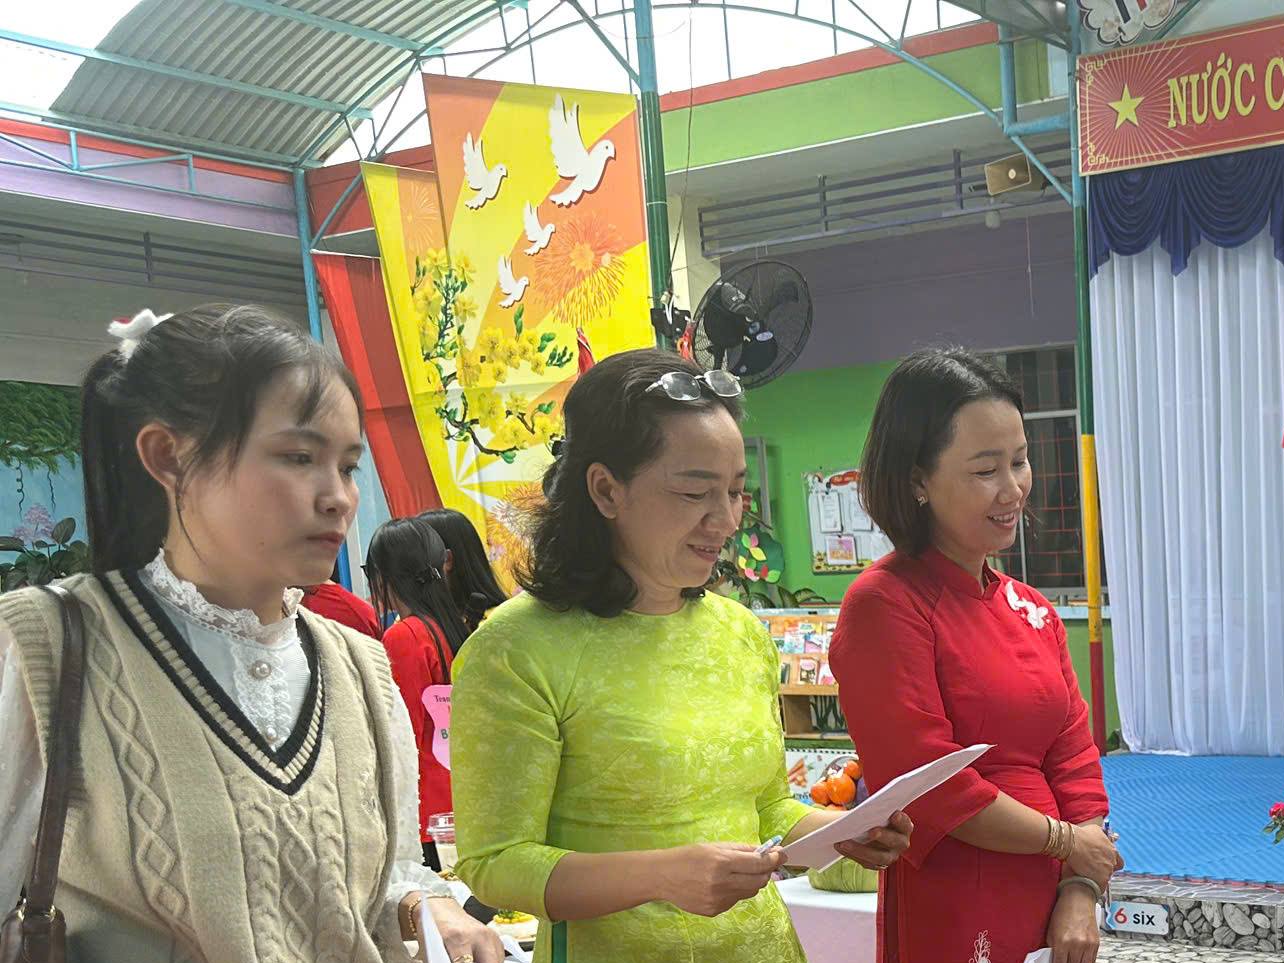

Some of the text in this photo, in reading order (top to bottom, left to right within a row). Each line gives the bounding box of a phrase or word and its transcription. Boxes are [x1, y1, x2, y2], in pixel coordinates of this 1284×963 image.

[1167, 52, 1256, 128] NƯỚC
[1114, 907, 1156, 926] 6 six
